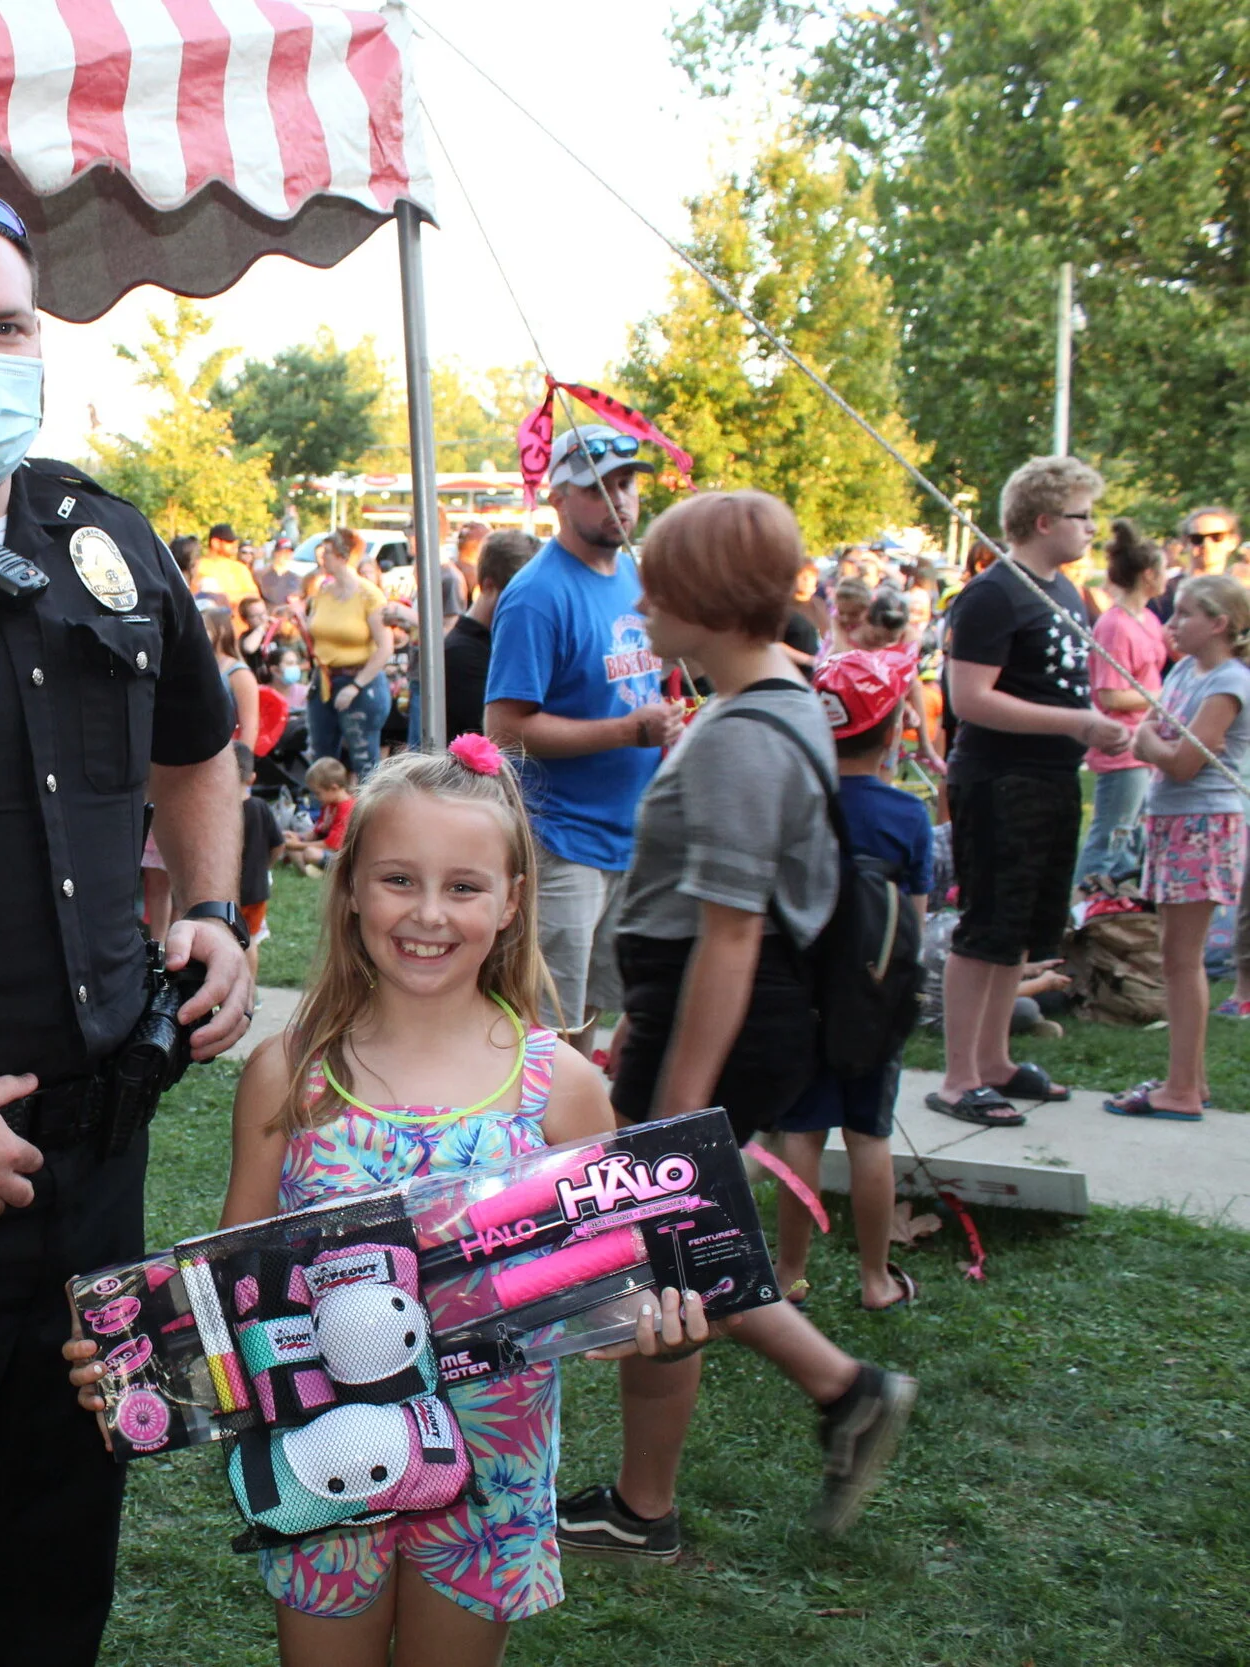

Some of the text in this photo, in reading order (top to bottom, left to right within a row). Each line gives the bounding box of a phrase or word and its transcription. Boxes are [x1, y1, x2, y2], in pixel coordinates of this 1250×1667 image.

[557, 1153, 696, 1221] HALO
[459, 1219, 537, 1262] HALO
[688, 1228, 742, 1246] FEATURES:
[313, 1264, 377, 1285] WIPEOUT
[275, 1331, 311, 1346] WIPEOUT
[132, 1435, 170, 1451] WHEELS
